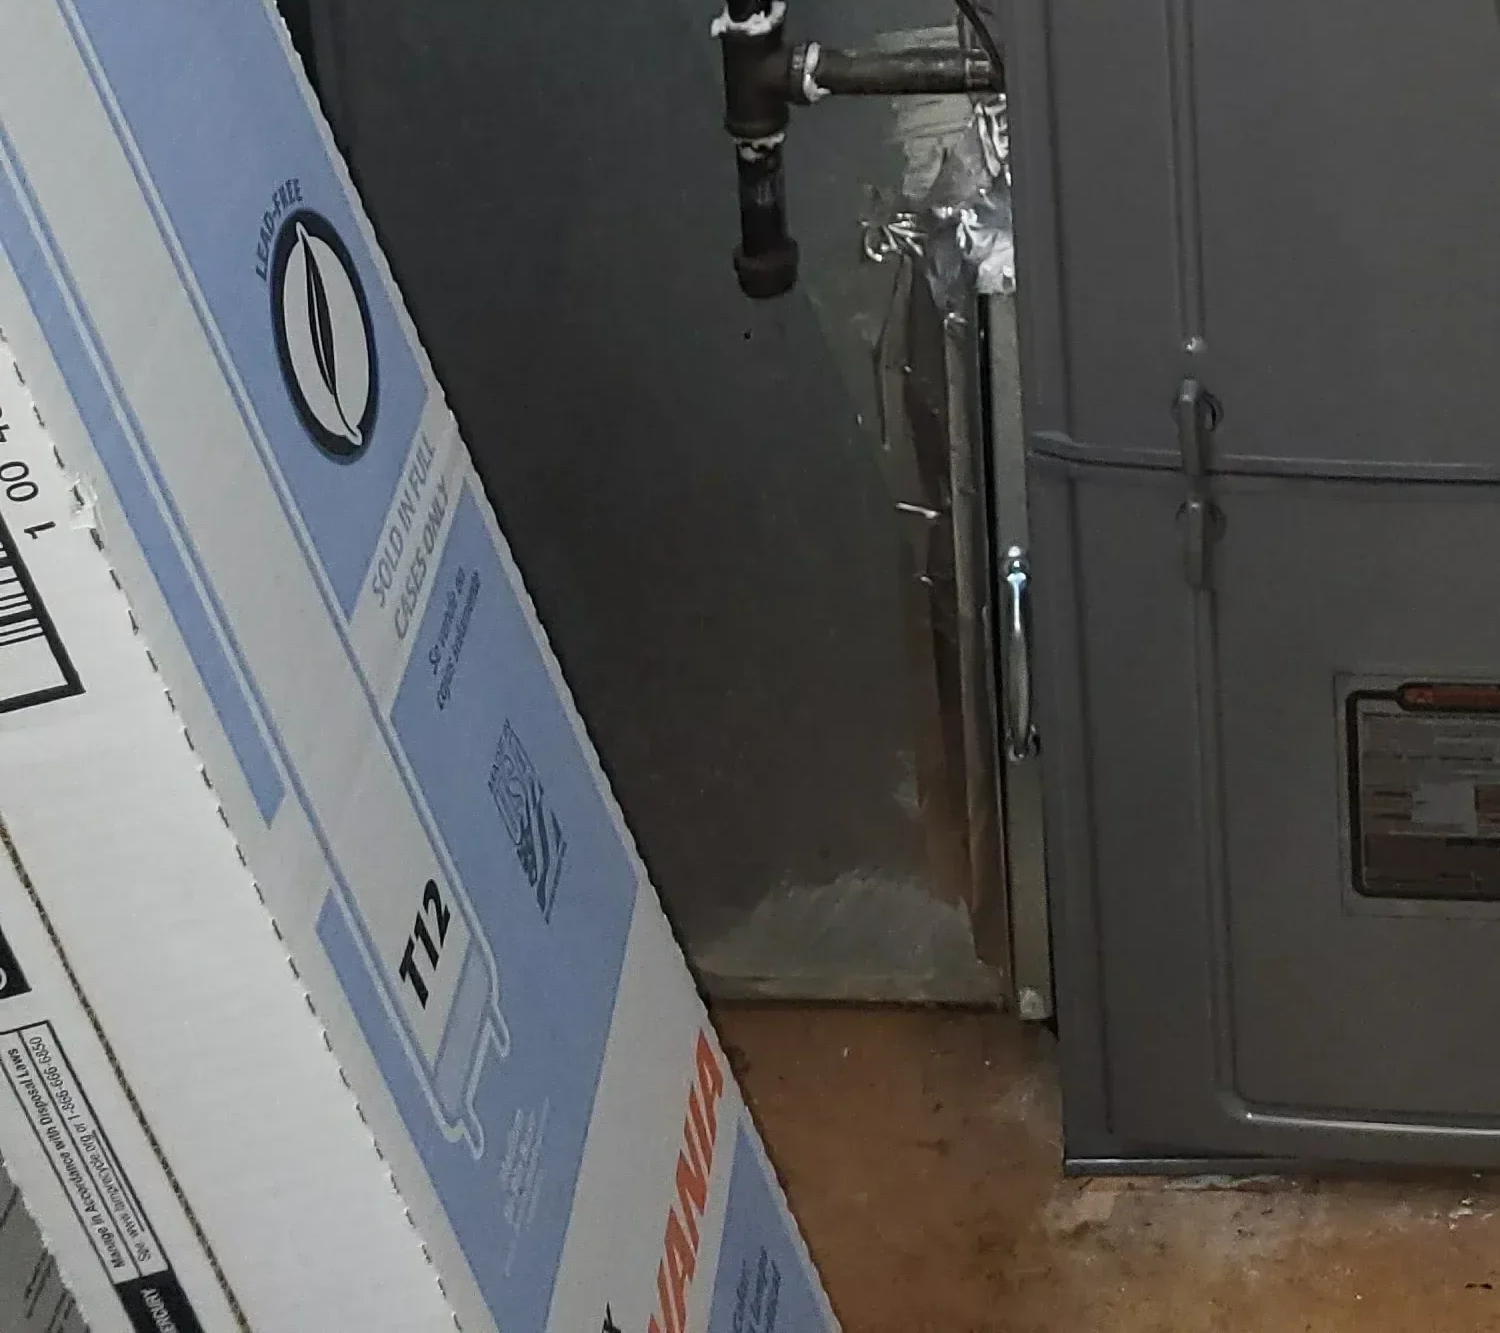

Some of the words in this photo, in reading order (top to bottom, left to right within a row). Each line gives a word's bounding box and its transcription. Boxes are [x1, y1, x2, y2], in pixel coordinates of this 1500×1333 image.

[255, 178, 303, 281] LEAD-FREE
[371, 528, 404, 609] SOLD
[397, 492, 415, 531] IN
[409, 431, 436, 499] FULL
[393, 547, 428, 639] CASES
[421, 474, 450, 554] ONLY
[398, 878, 451, 1009] T12
[7, 1047, 30, 1084] Laws
[29, 1081, 55, 1126] Disposal
[47, 1127, 70, 1151] with
[59, 1152, 99, 1213] Accordance
[96, 1227, 125, 1268] Manage
